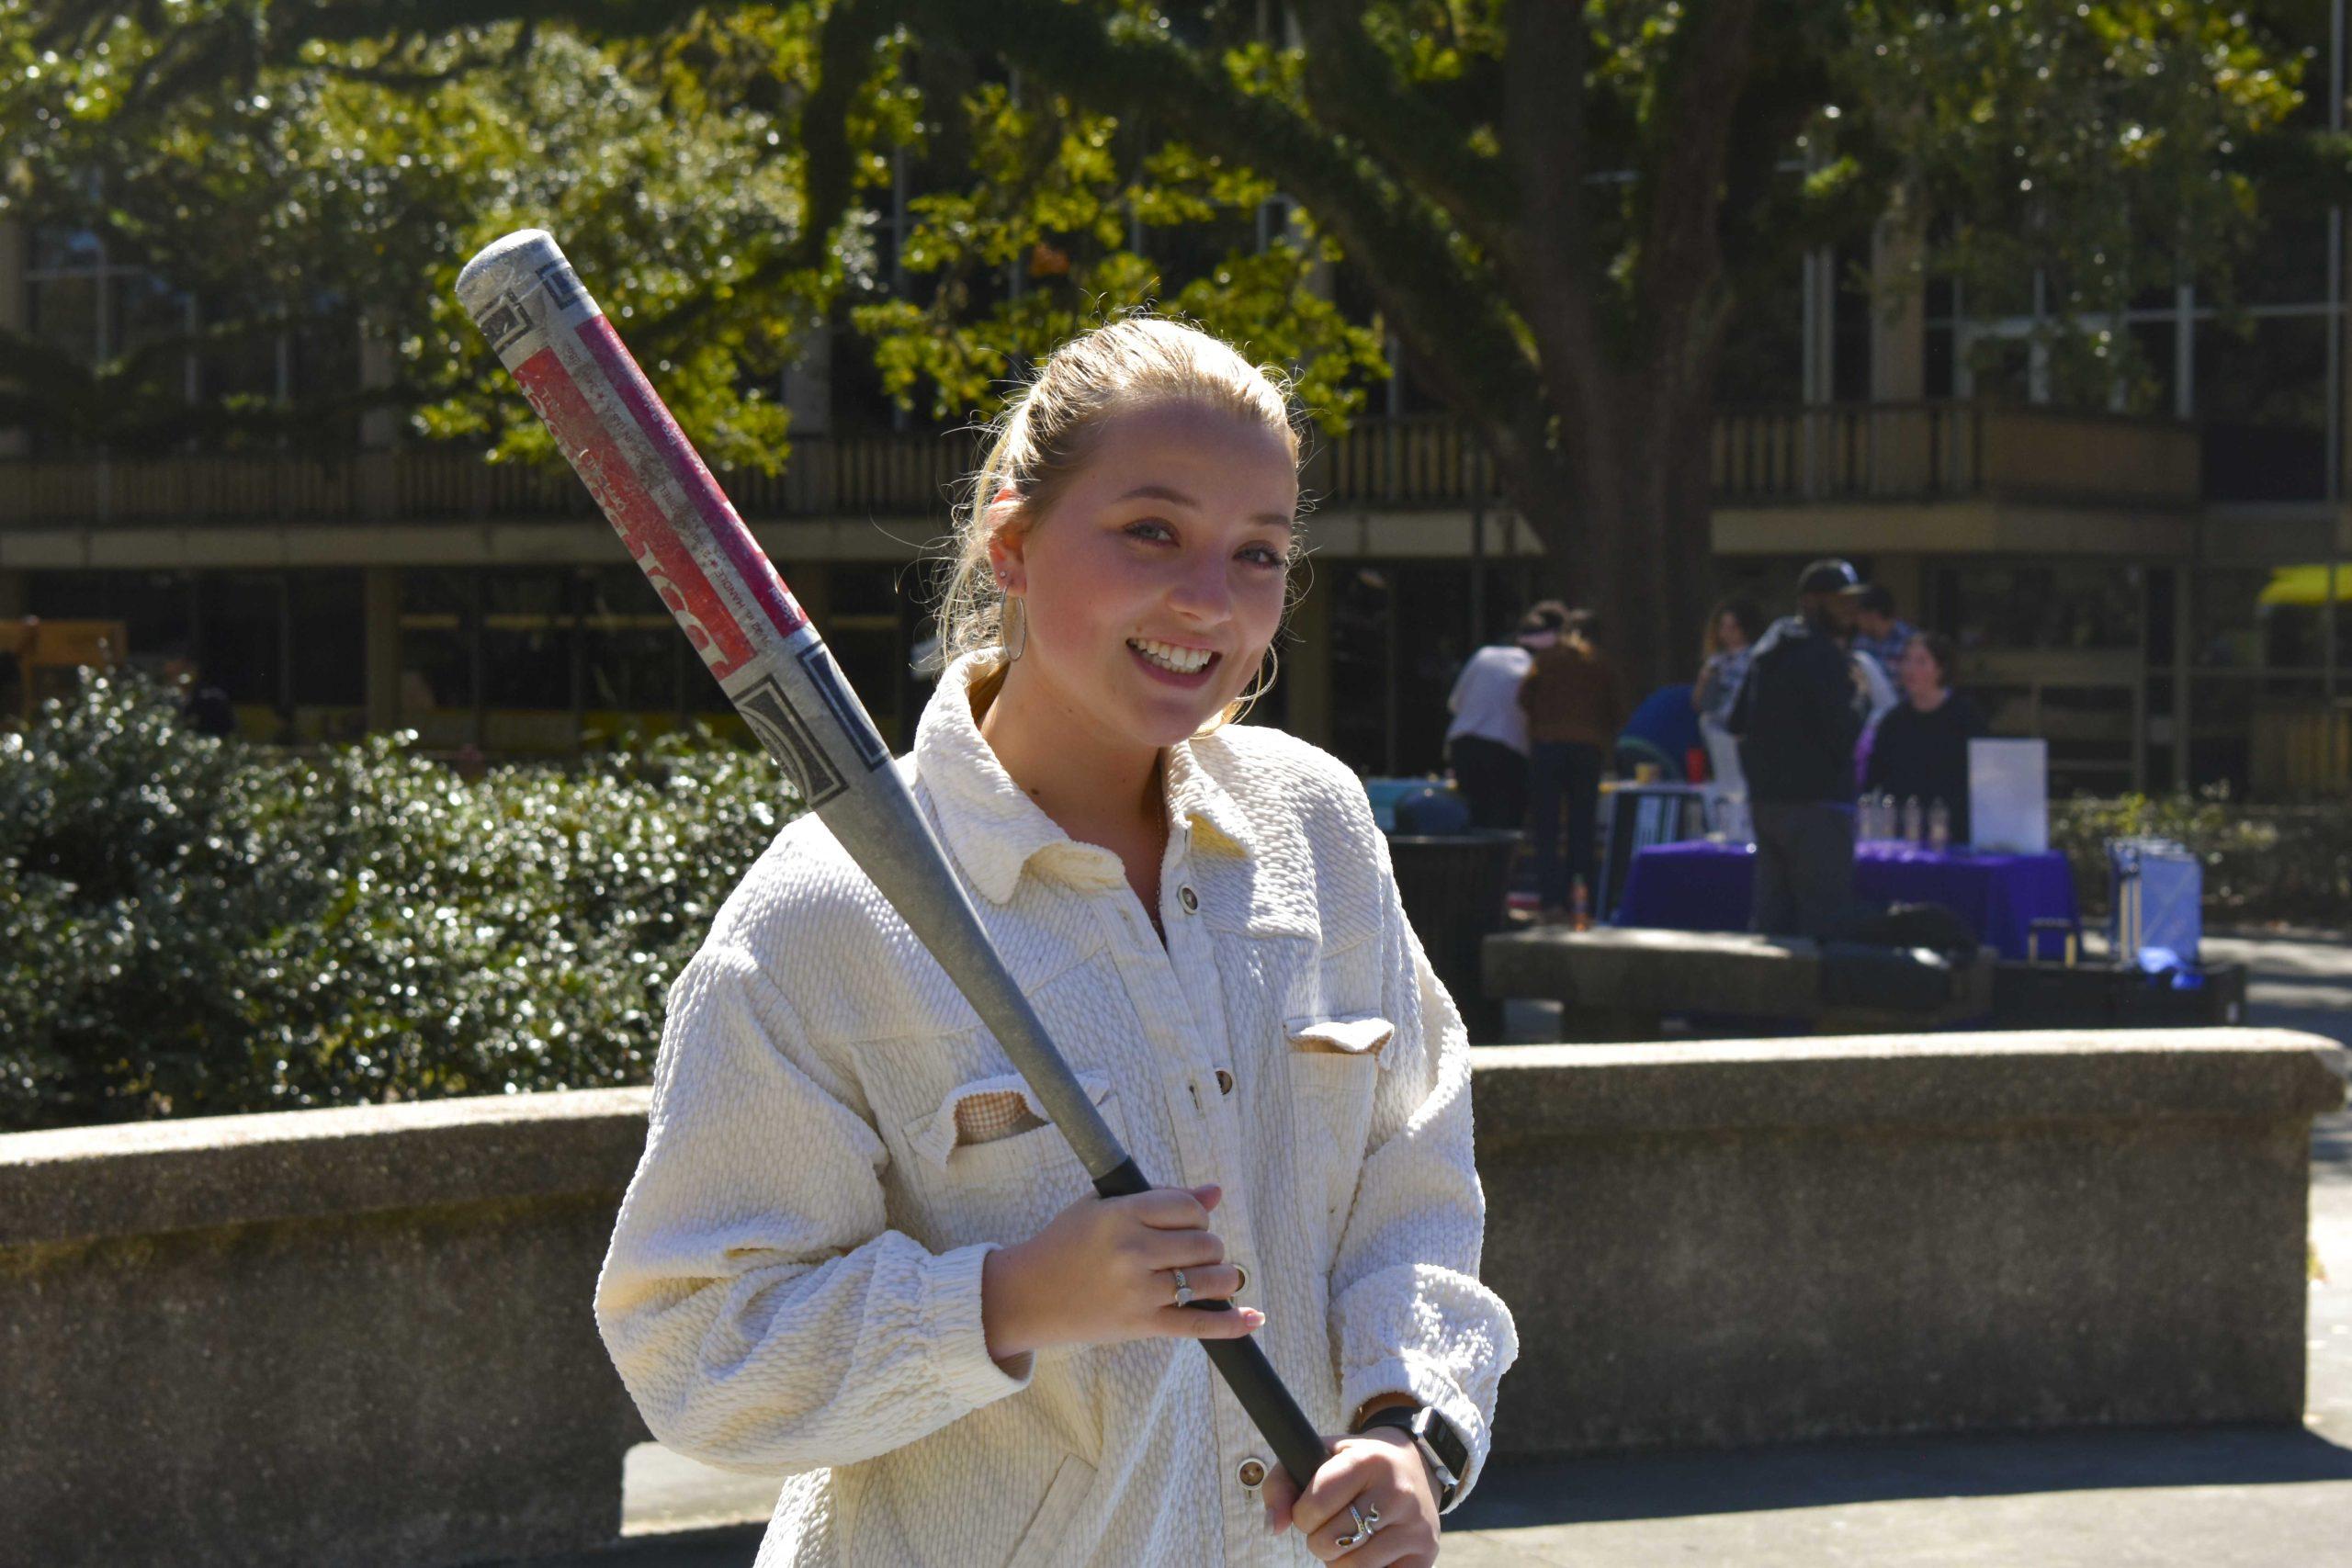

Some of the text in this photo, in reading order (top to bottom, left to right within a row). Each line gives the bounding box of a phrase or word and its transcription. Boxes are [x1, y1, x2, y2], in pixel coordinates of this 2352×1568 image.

[658, 423, 678, 446] Pro
[713, 568, 746, 610] HANDLE
[766, 585, 797, 626] Model
